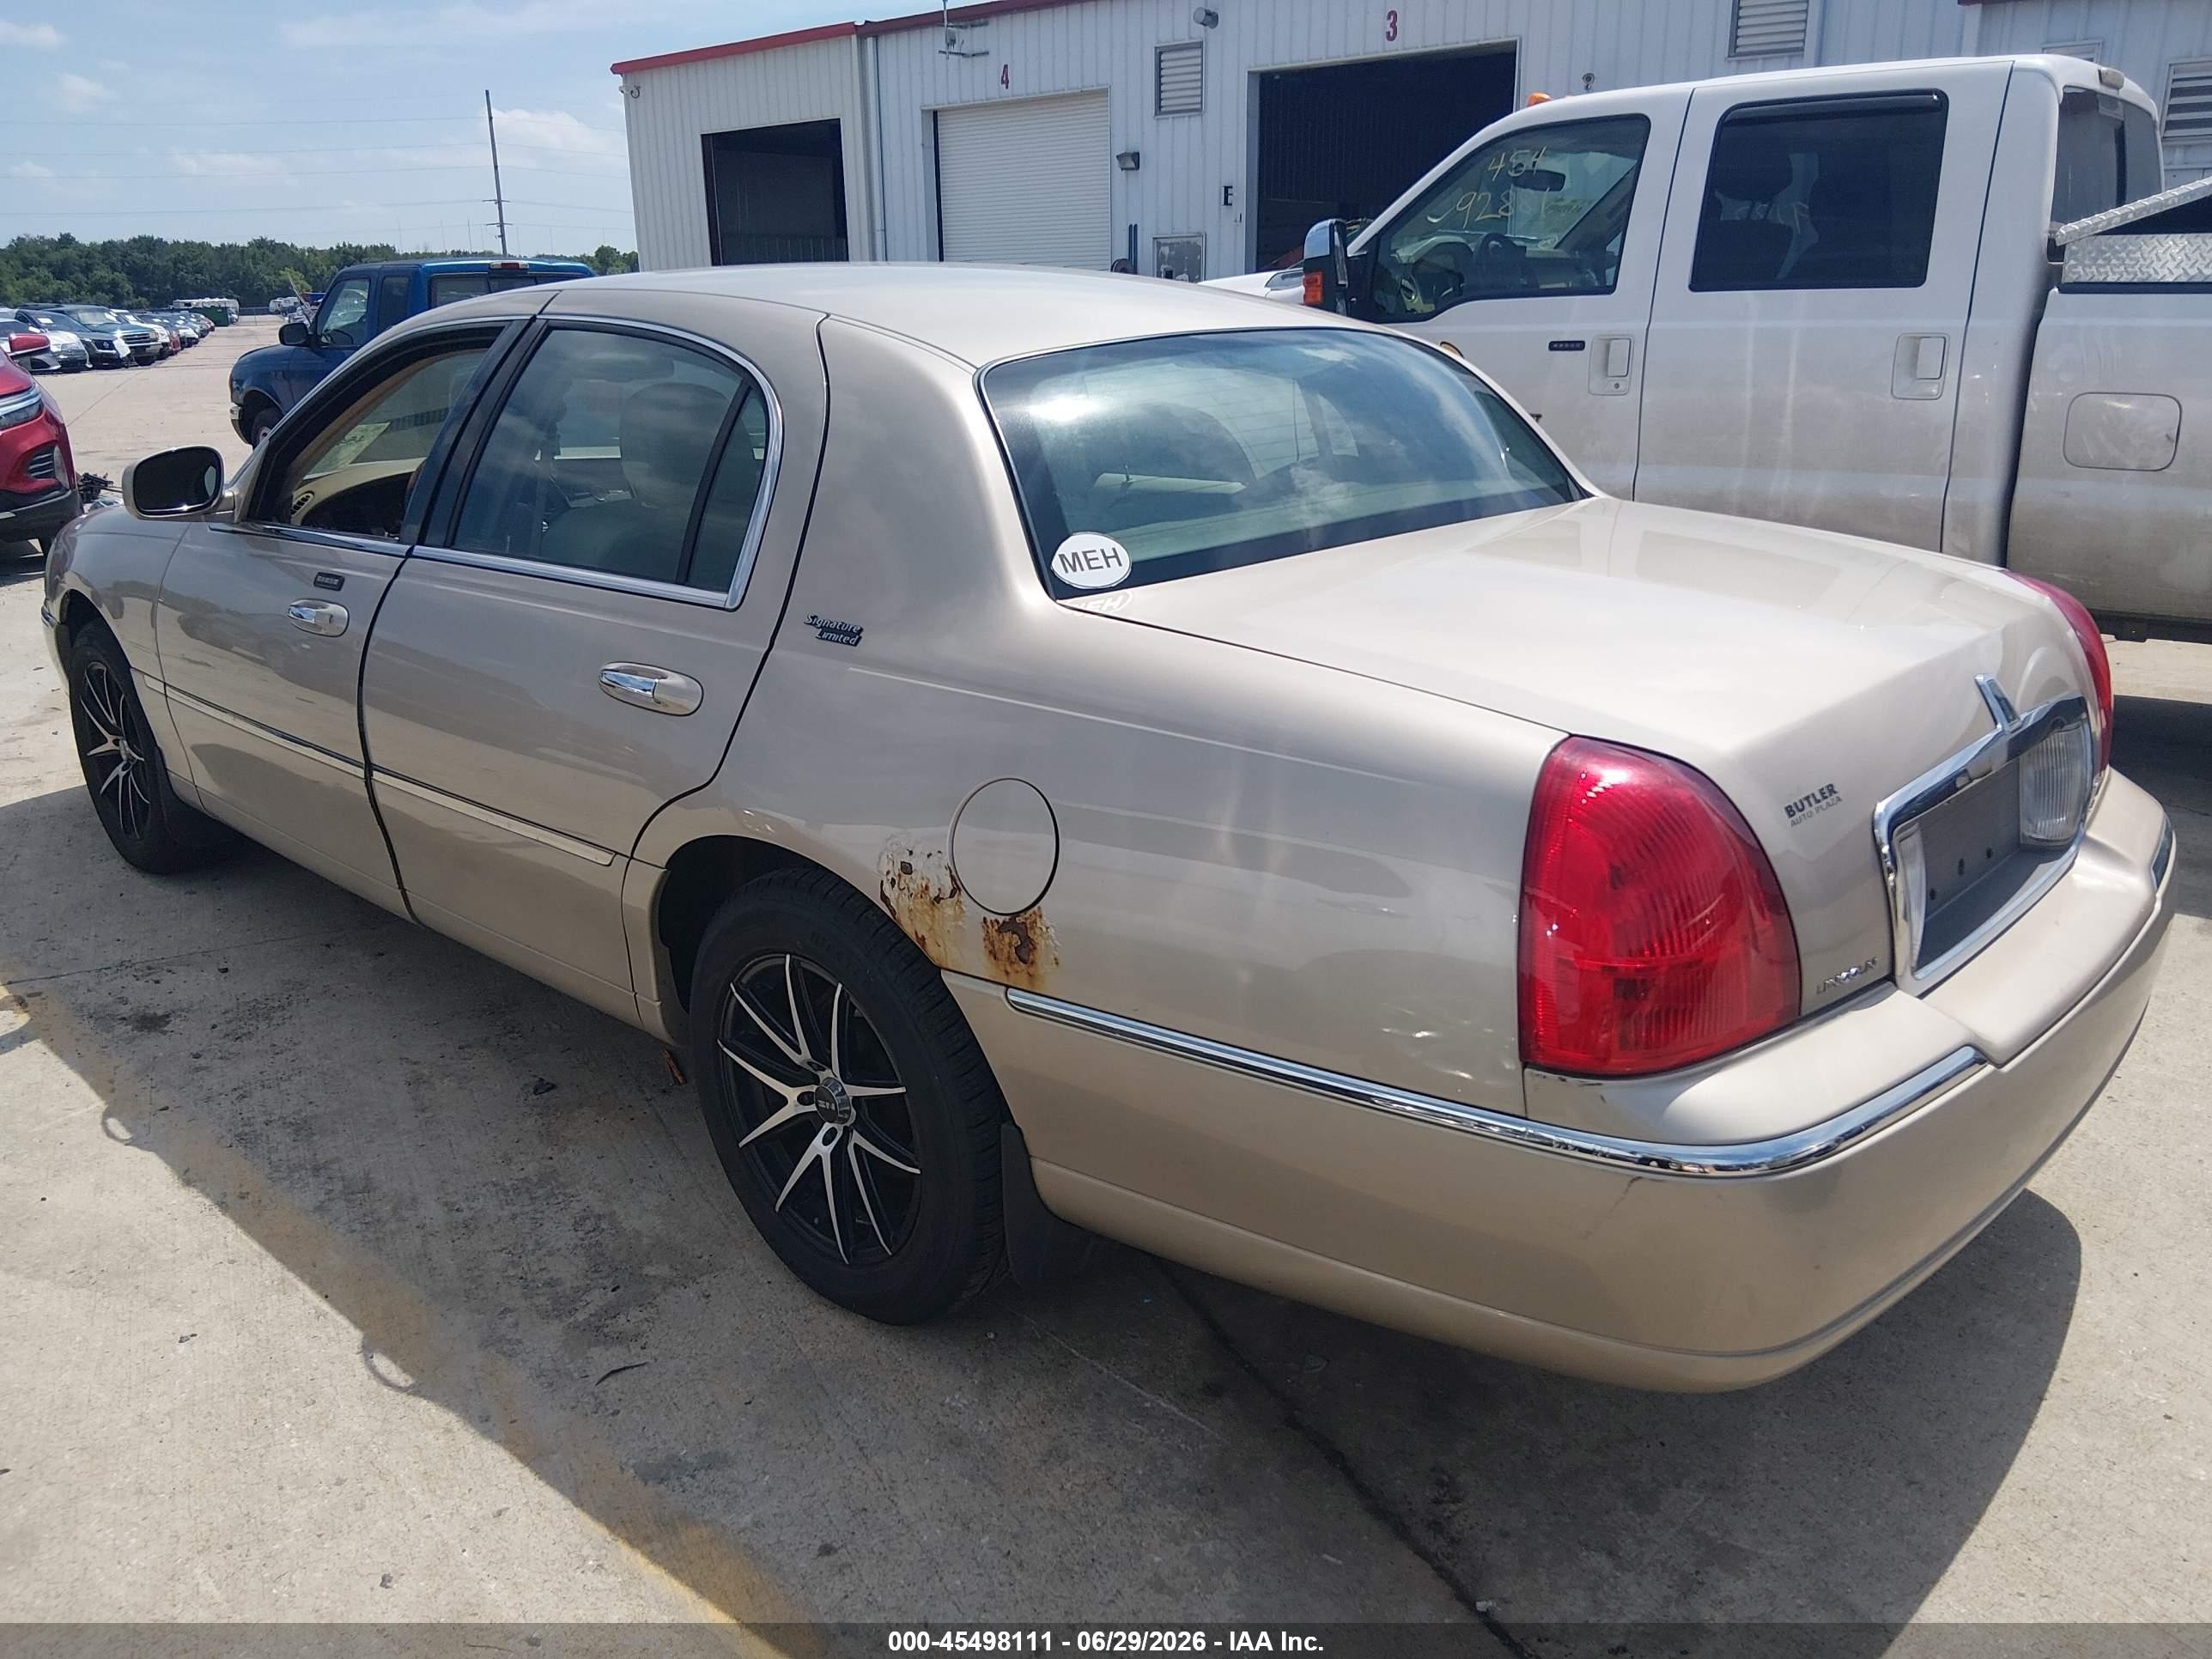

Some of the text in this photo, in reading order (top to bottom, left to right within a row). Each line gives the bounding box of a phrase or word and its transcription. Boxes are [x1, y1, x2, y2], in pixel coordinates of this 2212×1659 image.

[1386, 10, 1398, 41] 3
[1000, 64, 1009, 89] 4
[1487, 146, 1547, 182] 454
[1224, 185, 1233, 206] E
[1058, 548, 1122, 574] MEH
[805, 614, 862, 634] Signature
[816, 628, 860, 645] Limited
[1784, 783, 1838, 818] BUTLER
[1790, 796, 1842, 827] AUTO PLAZA
